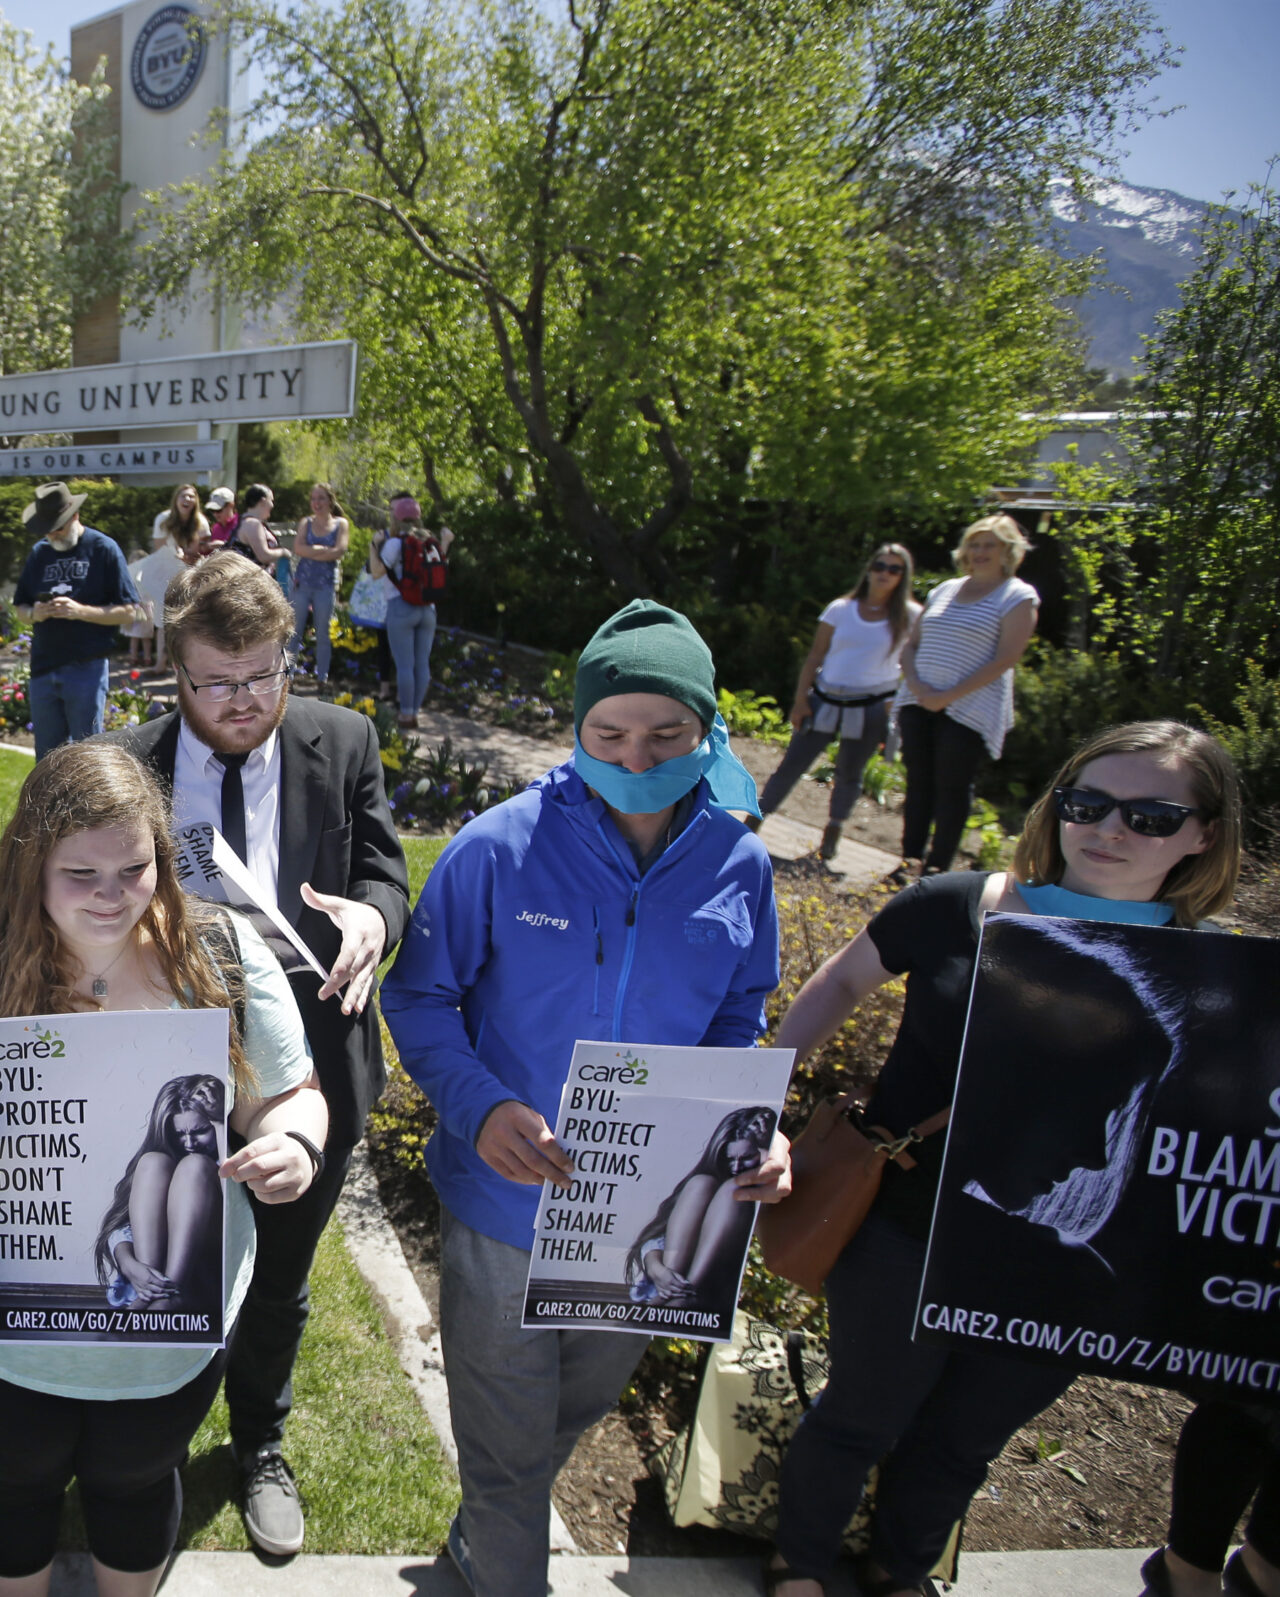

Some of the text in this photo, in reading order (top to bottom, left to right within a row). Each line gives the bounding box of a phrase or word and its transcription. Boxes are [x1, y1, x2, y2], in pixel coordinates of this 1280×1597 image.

[79, 368, 303, 411] UNIVERSITY
[13, 455, 31, 469] IS
[44, 453, 86, 468] OUR
[100, 449, 195, 467] CAMPUS
[42, 557, 90, 583] BYU
[183, 829, 223, 883] SHAME
[516, 910, 569, 930] Jeffrey
[578, 1064, 649, 1085] care2
[570, 1087, 621, 1114] BYU:
[563, 1117, 656, 1147] PROTECT
[544, 1208, 617, 1235] SHAME
[1176, 1184, 1280, 1248] VICT
[540, 1238, 598, 1263] THEM.
[6, 1311, 210, 1332] CARE2.COM/GO/Z/BYUVICTIMS
[536, 1301, 720, 1329] CARE2.COM/GO/Z/BYUVICTIMS
[922, 1303, 1280, 1391] CARE2.COM/GO/Z/BYUVICT
